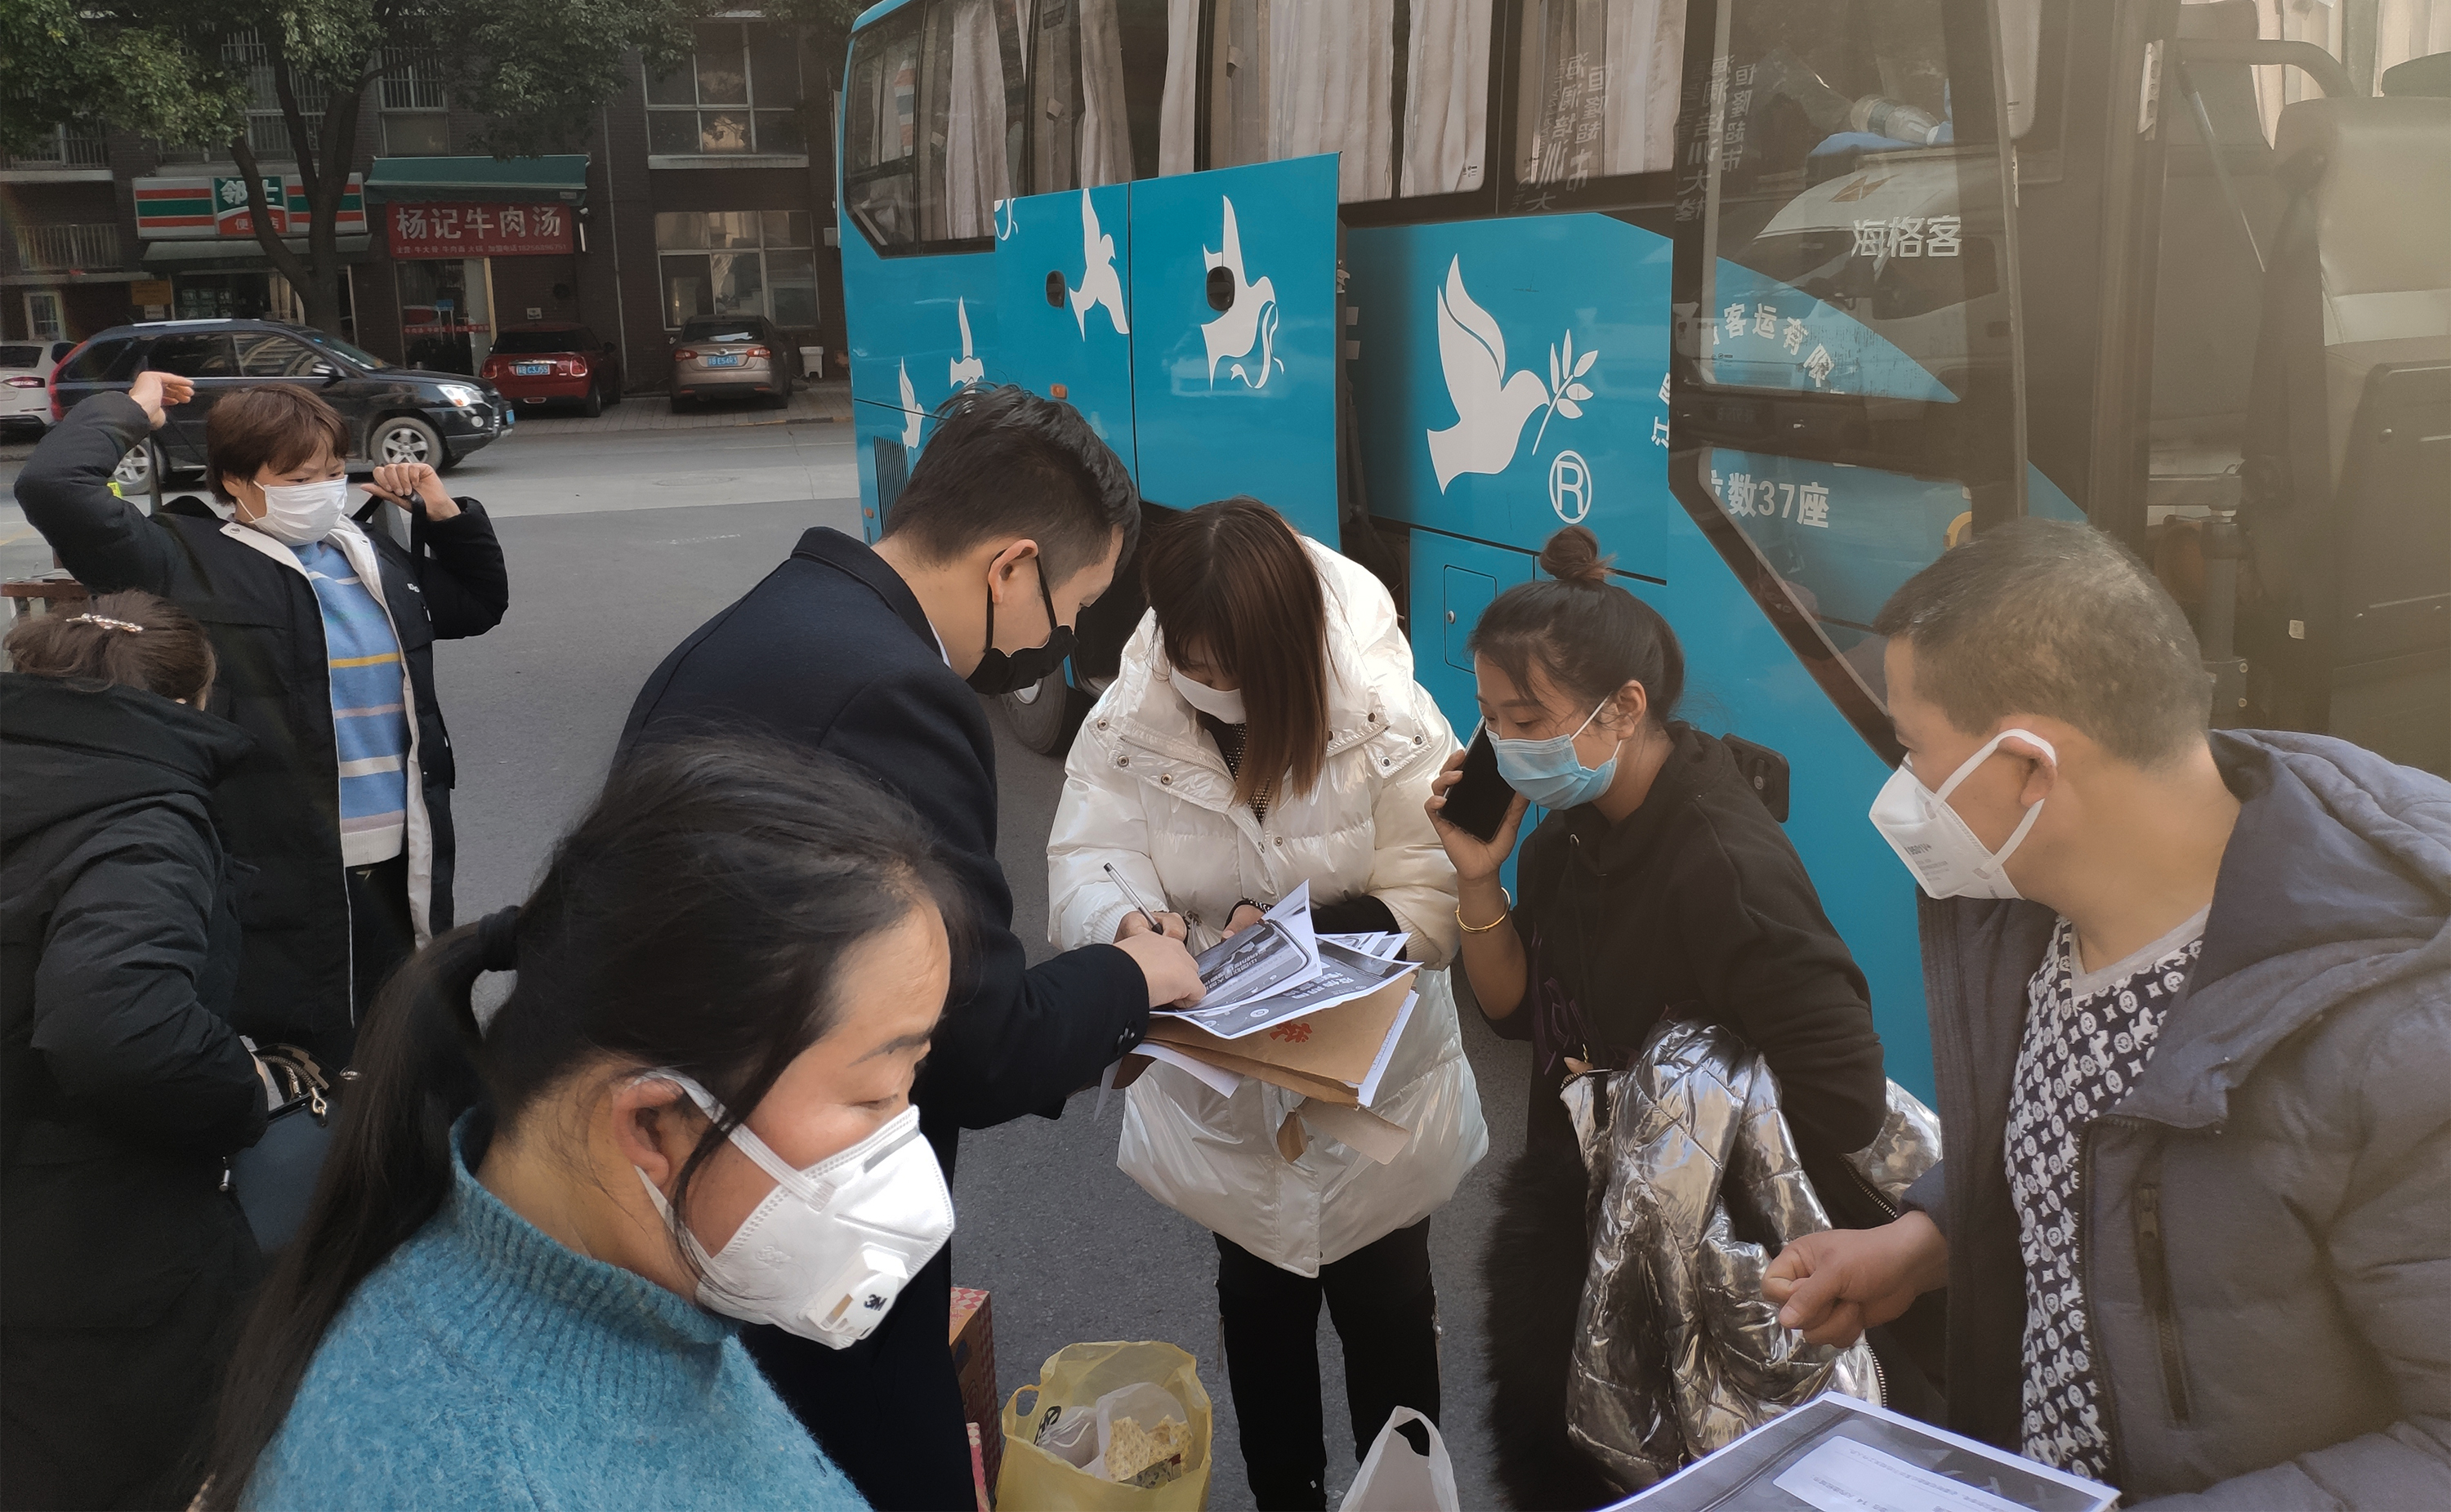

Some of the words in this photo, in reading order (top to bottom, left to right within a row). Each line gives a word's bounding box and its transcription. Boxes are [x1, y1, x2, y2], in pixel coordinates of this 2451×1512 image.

[234, 217, 279, 230] 便店
[395, 206, 561, 240] 杨记牛肉汤
[1851, 214, 1962, 258] 海格客
[864, 1294, 888, 1312] 3M
